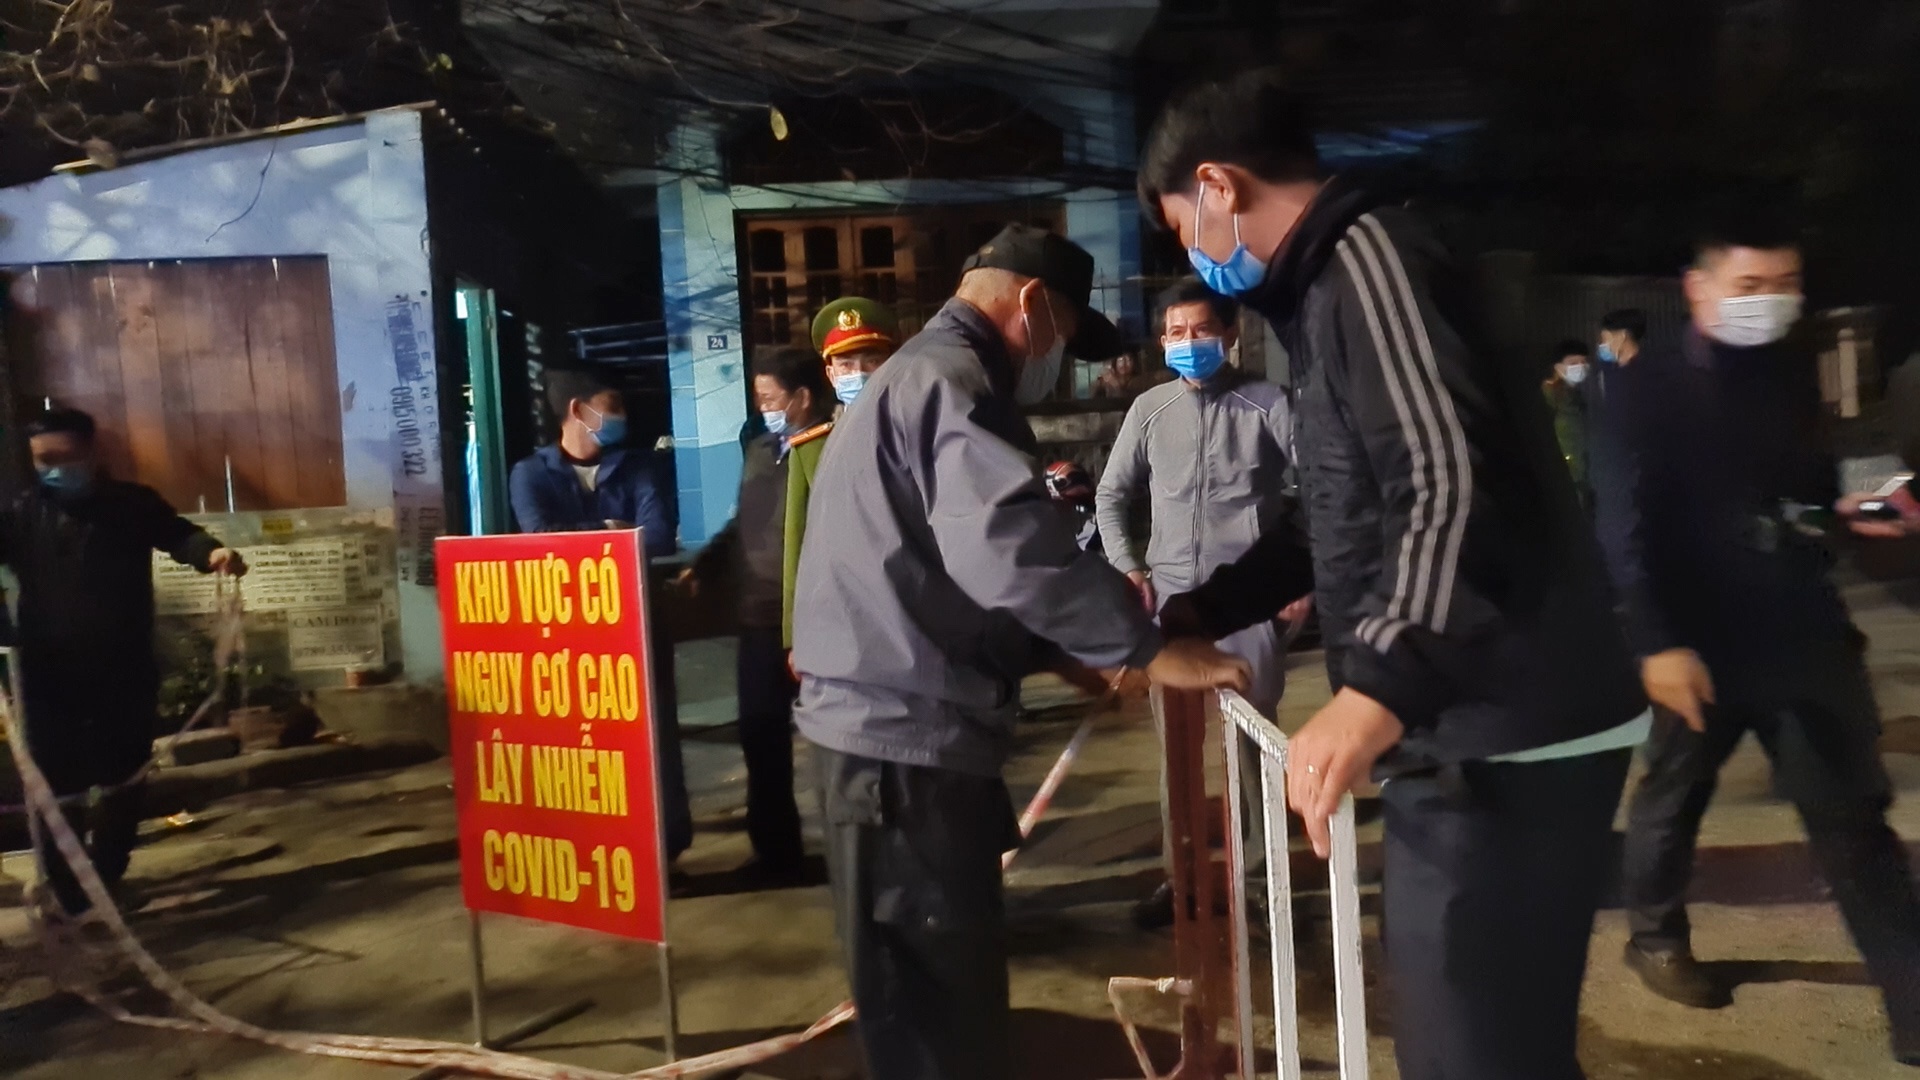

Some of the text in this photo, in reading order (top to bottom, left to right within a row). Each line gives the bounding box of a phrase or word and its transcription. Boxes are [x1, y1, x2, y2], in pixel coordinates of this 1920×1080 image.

[454, 560, 511, 624] KHU
[514, 552, 572, 638] VỰC
[579, 542, 621, 625] CÓ
[453, 648, 639, 722] NGUY CƠ CAO
[476, 723, 628, 817] LÂY NHIỄM
[483, 829, 636, 913] COVID-19
